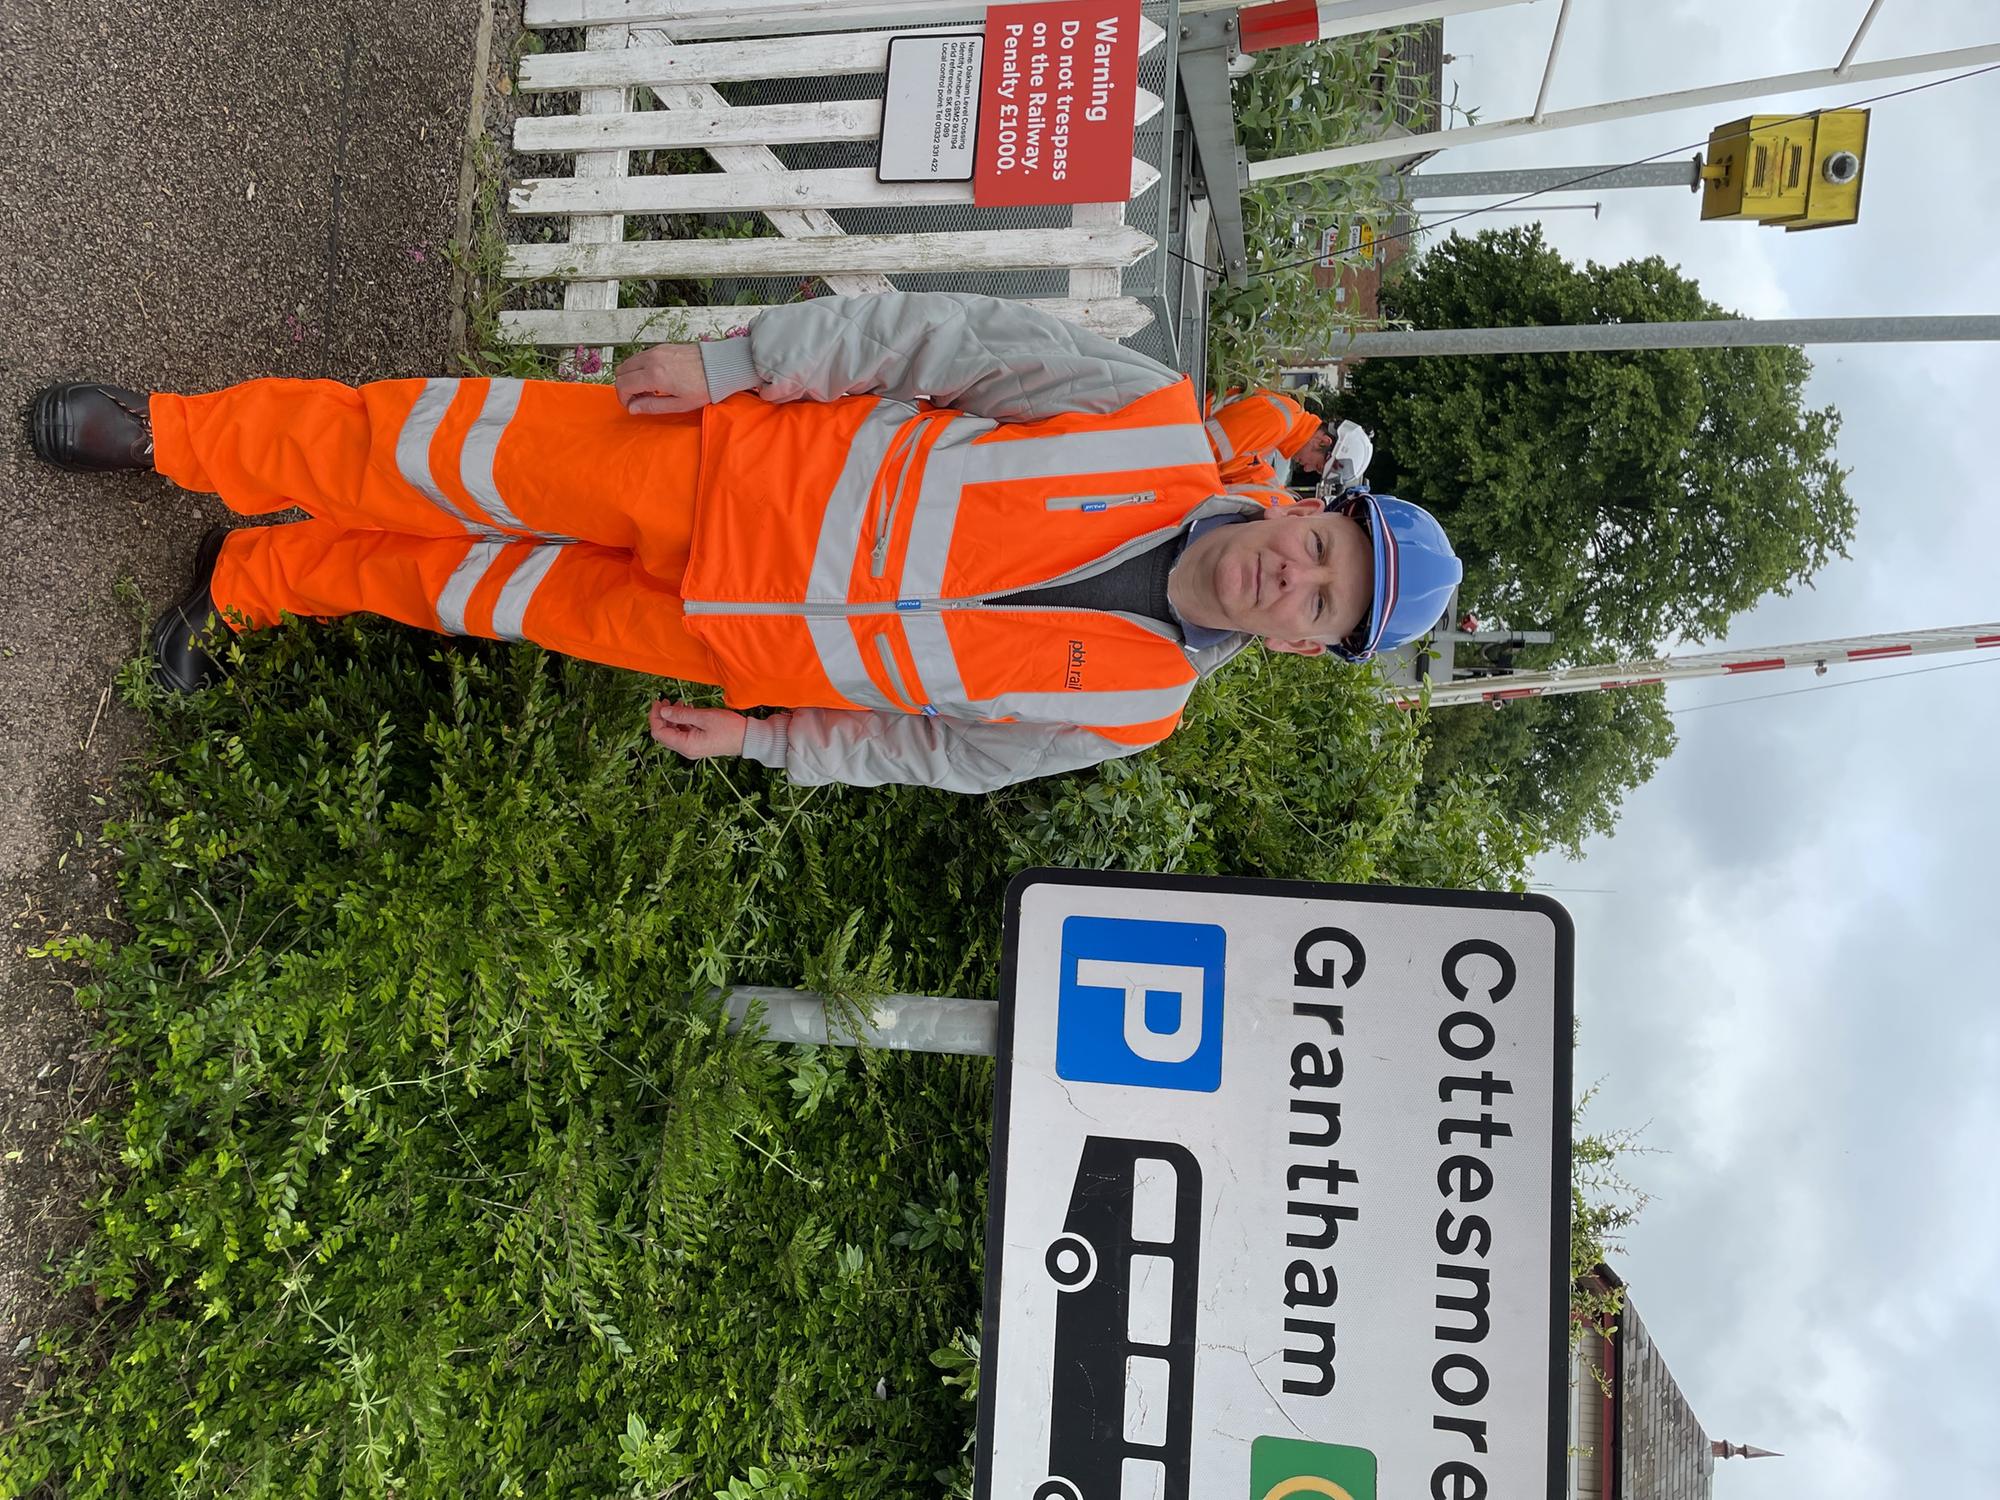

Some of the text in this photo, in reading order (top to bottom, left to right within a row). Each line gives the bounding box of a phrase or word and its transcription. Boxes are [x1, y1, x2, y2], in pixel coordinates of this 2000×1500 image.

[938, 63, 946, 88] control
[946, 96, 952, 106] SK
[947, 59, 956, 95] reference:
[955, 71, 963, 99] number:
[957, 42, 965, 69] Identity
[959, 42, 975, 149] Name: Oakham Level Crossing
[996, 24, 1022, 175] Penalty £1000.
[1022, 23, 1049, 175] on the Railway.
[1051, 21, 1079, 180] Do not trespass
[1085, 17, 1118, 121] Warning
[944, 108, 952, 121] 857
[1068, 640, 1086, 690] pbh rail
[1077, 959, 1204, 1063] P
[1282, 926, 1366, 1397] Grantham
[1431, 939, 1516, 1500] Cottesmore
